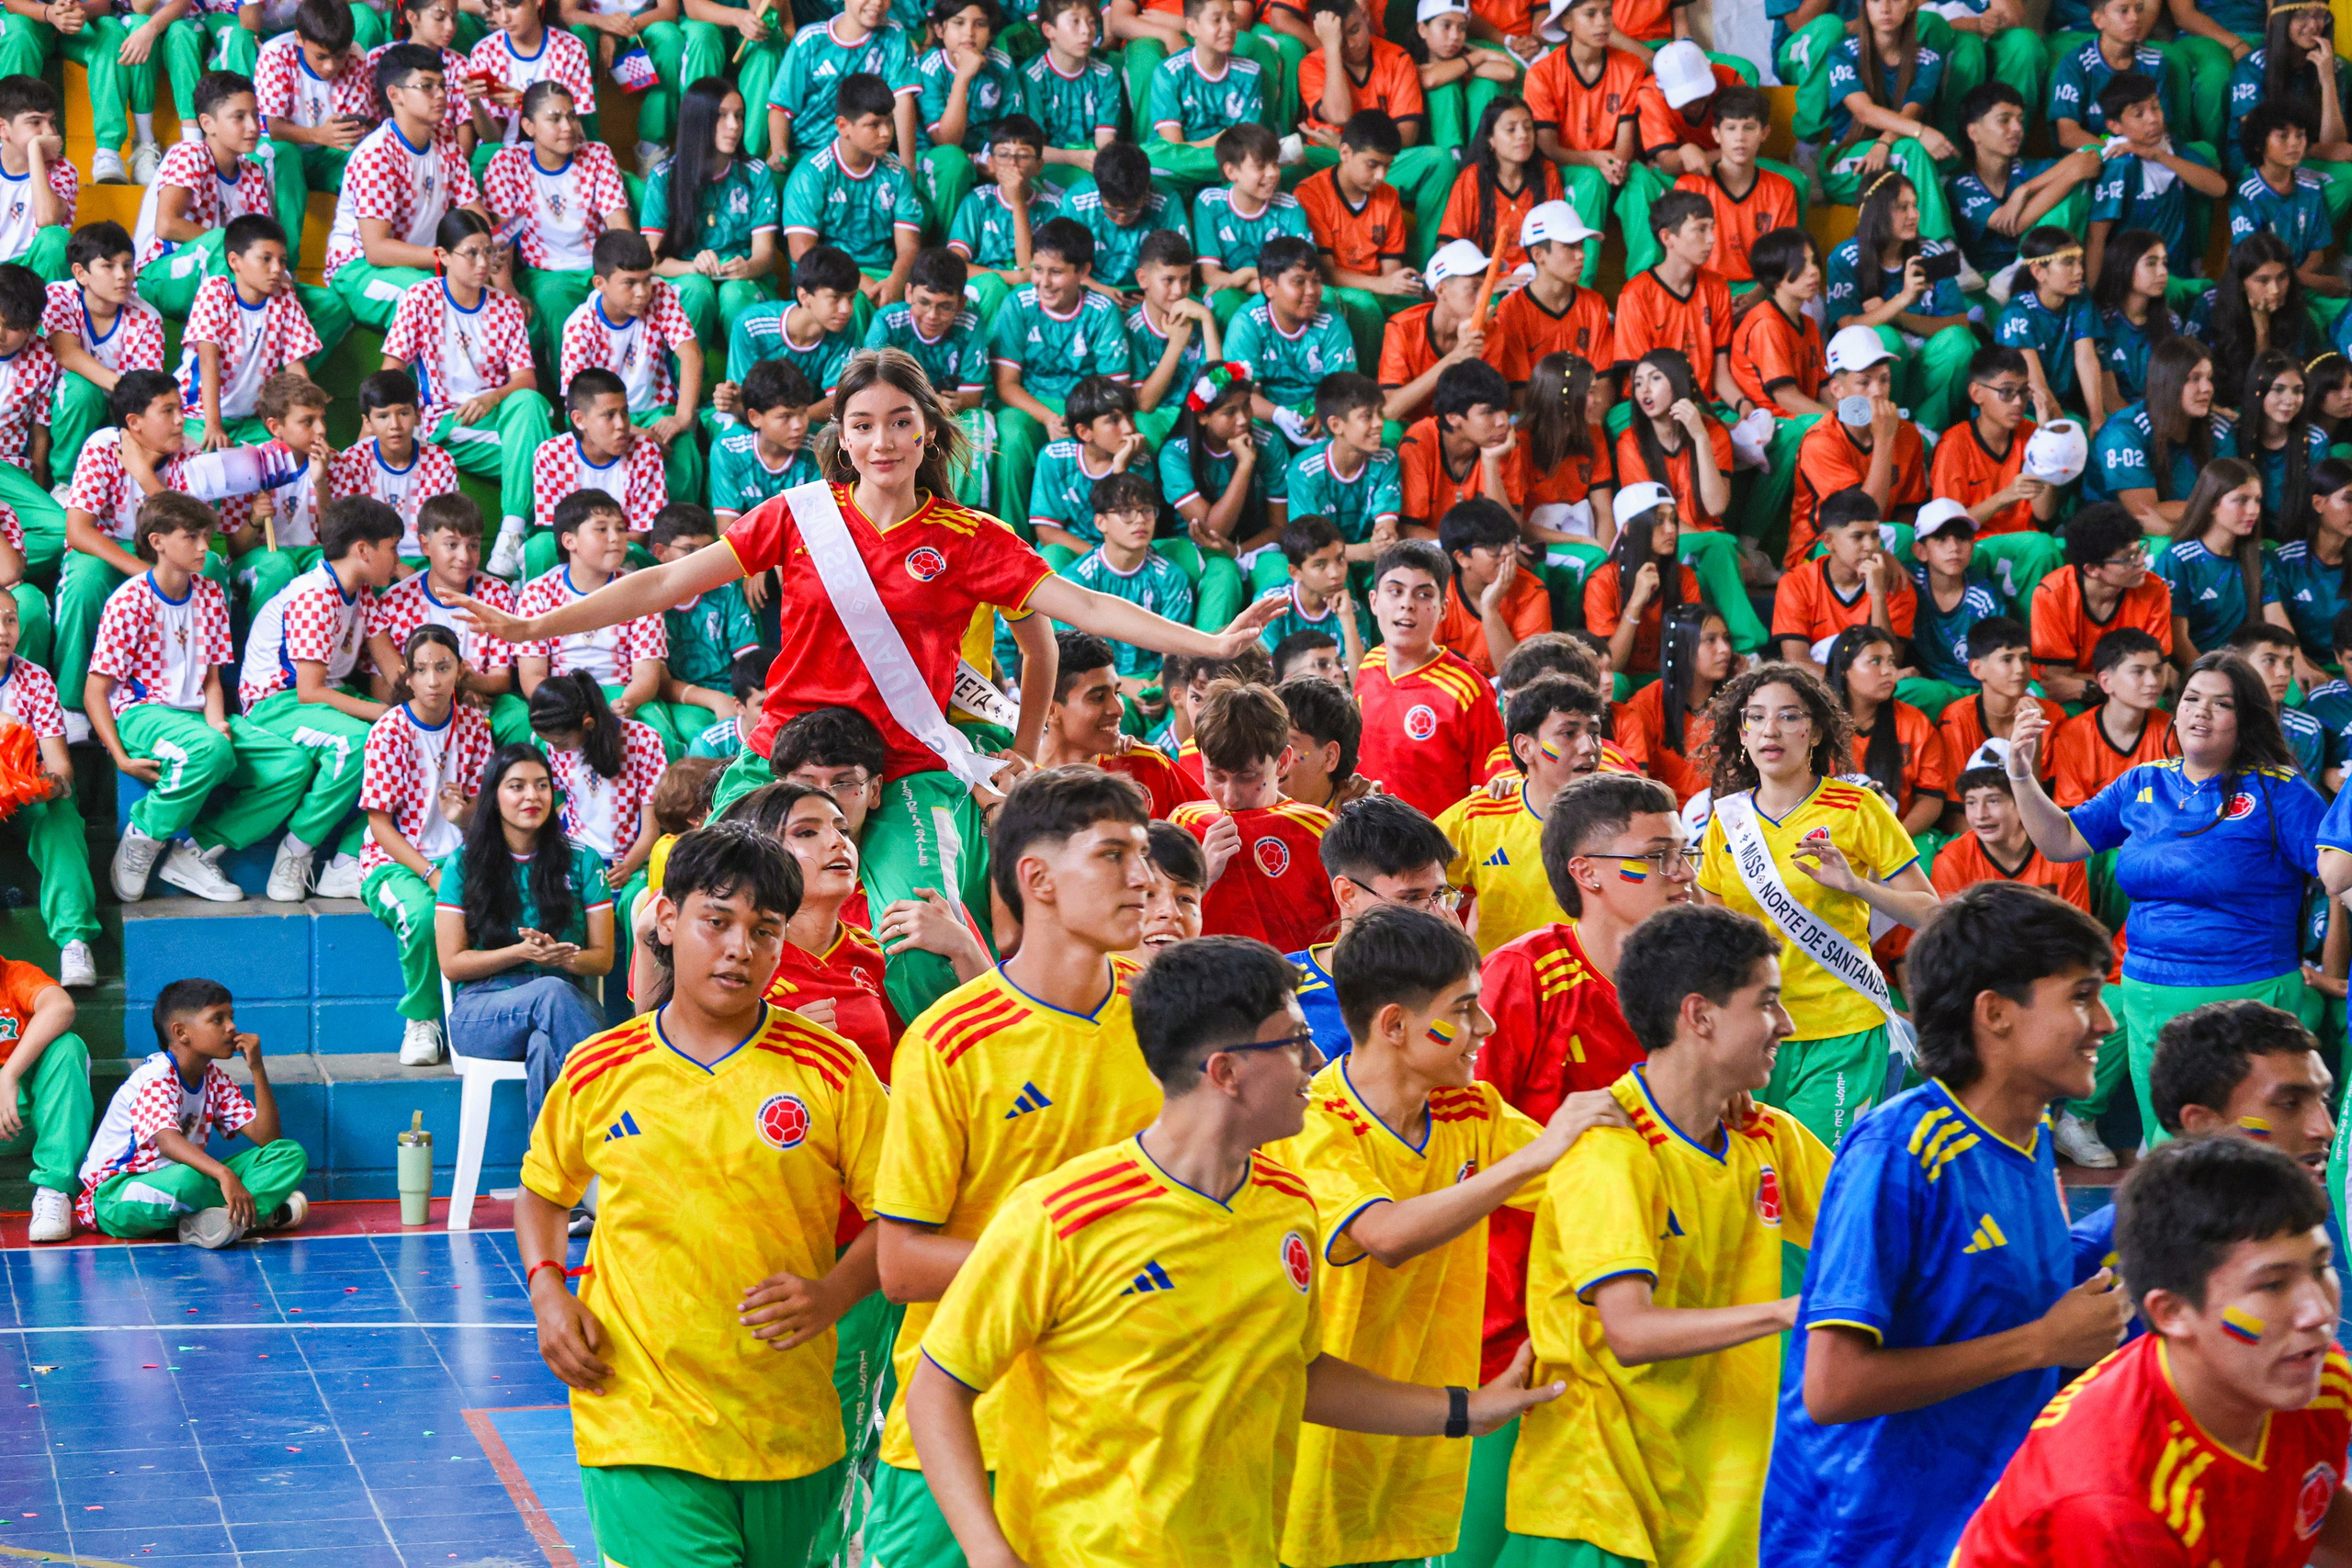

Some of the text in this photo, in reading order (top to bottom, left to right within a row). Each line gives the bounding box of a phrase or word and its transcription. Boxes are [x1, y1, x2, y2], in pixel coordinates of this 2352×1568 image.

[2107, 447, 2144, 469] 8-02
[1740, 840, 1766, 879] MISS
[1758, 880, 1807, 934] NORTE
[1799, 924, 1827, 952] DE
[1834, 1109, 1846, 1128] DE
[2335, 1118, 2348, 1161] SALLE
[854, 1402, 866, 1426] DE
